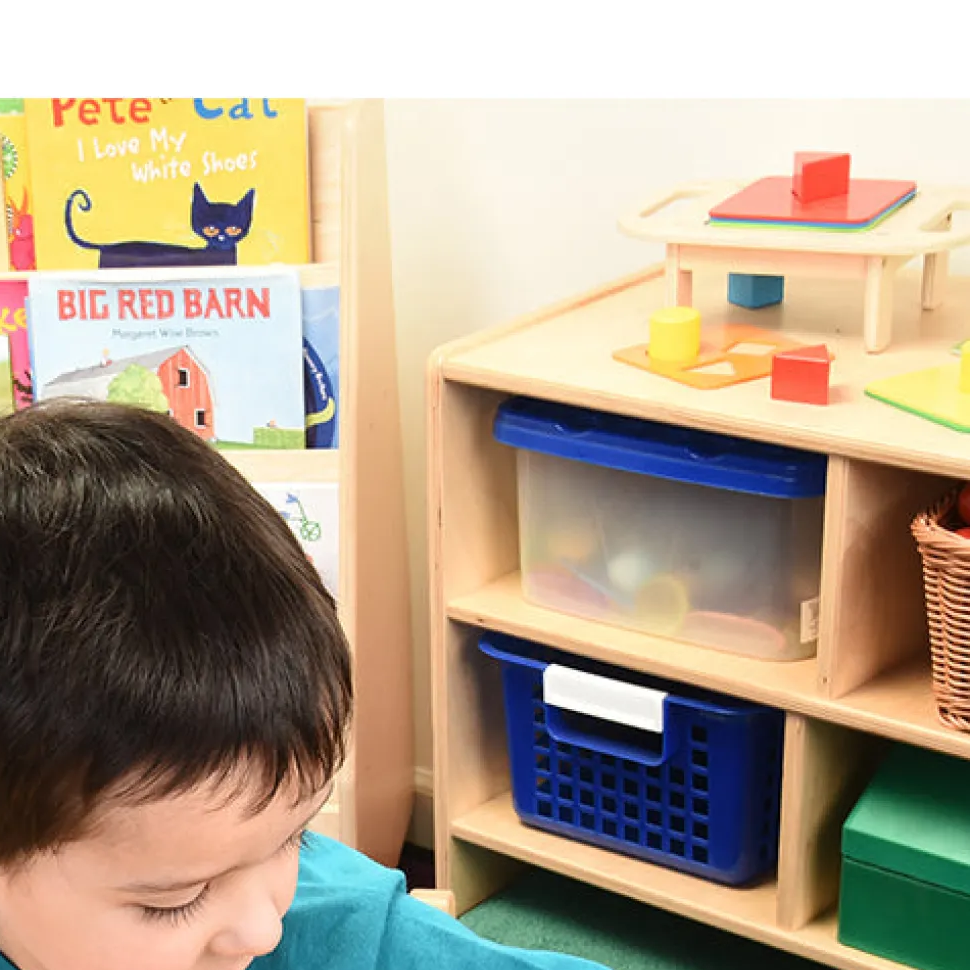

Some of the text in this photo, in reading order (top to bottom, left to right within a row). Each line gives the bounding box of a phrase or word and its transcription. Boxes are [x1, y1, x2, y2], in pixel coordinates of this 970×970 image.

[51, 98, 153, 127] Pete
[77, 127, 187, 162] I Love My
[131, 150, 258, 183] White Shoes
[57, 287, 271, 320] BIG RED BARN
